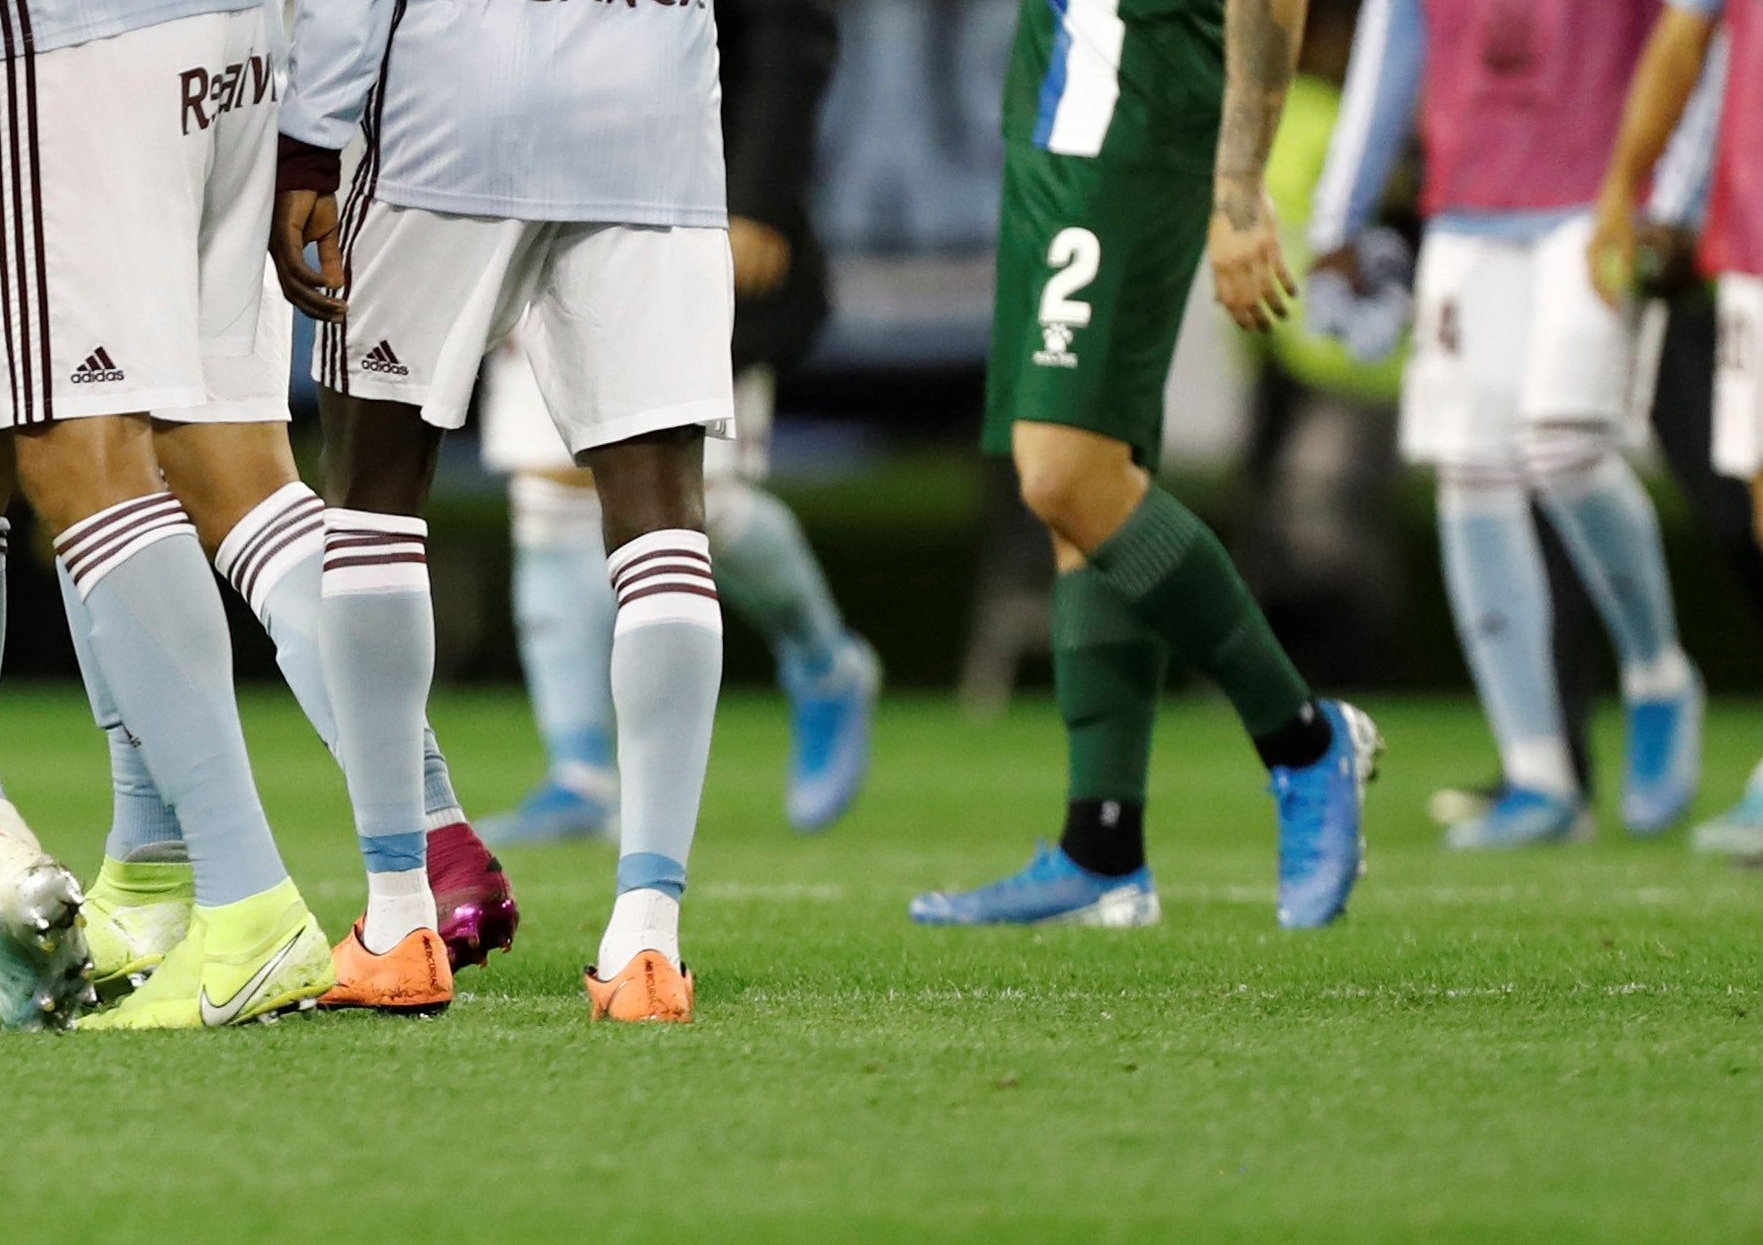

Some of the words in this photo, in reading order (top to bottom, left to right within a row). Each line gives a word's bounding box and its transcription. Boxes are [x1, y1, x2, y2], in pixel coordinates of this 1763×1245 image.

[1039, 227, 1101, 328] 2
[361, 360, 409, 375] adidas
[70, 368, 125, 384] adidas
